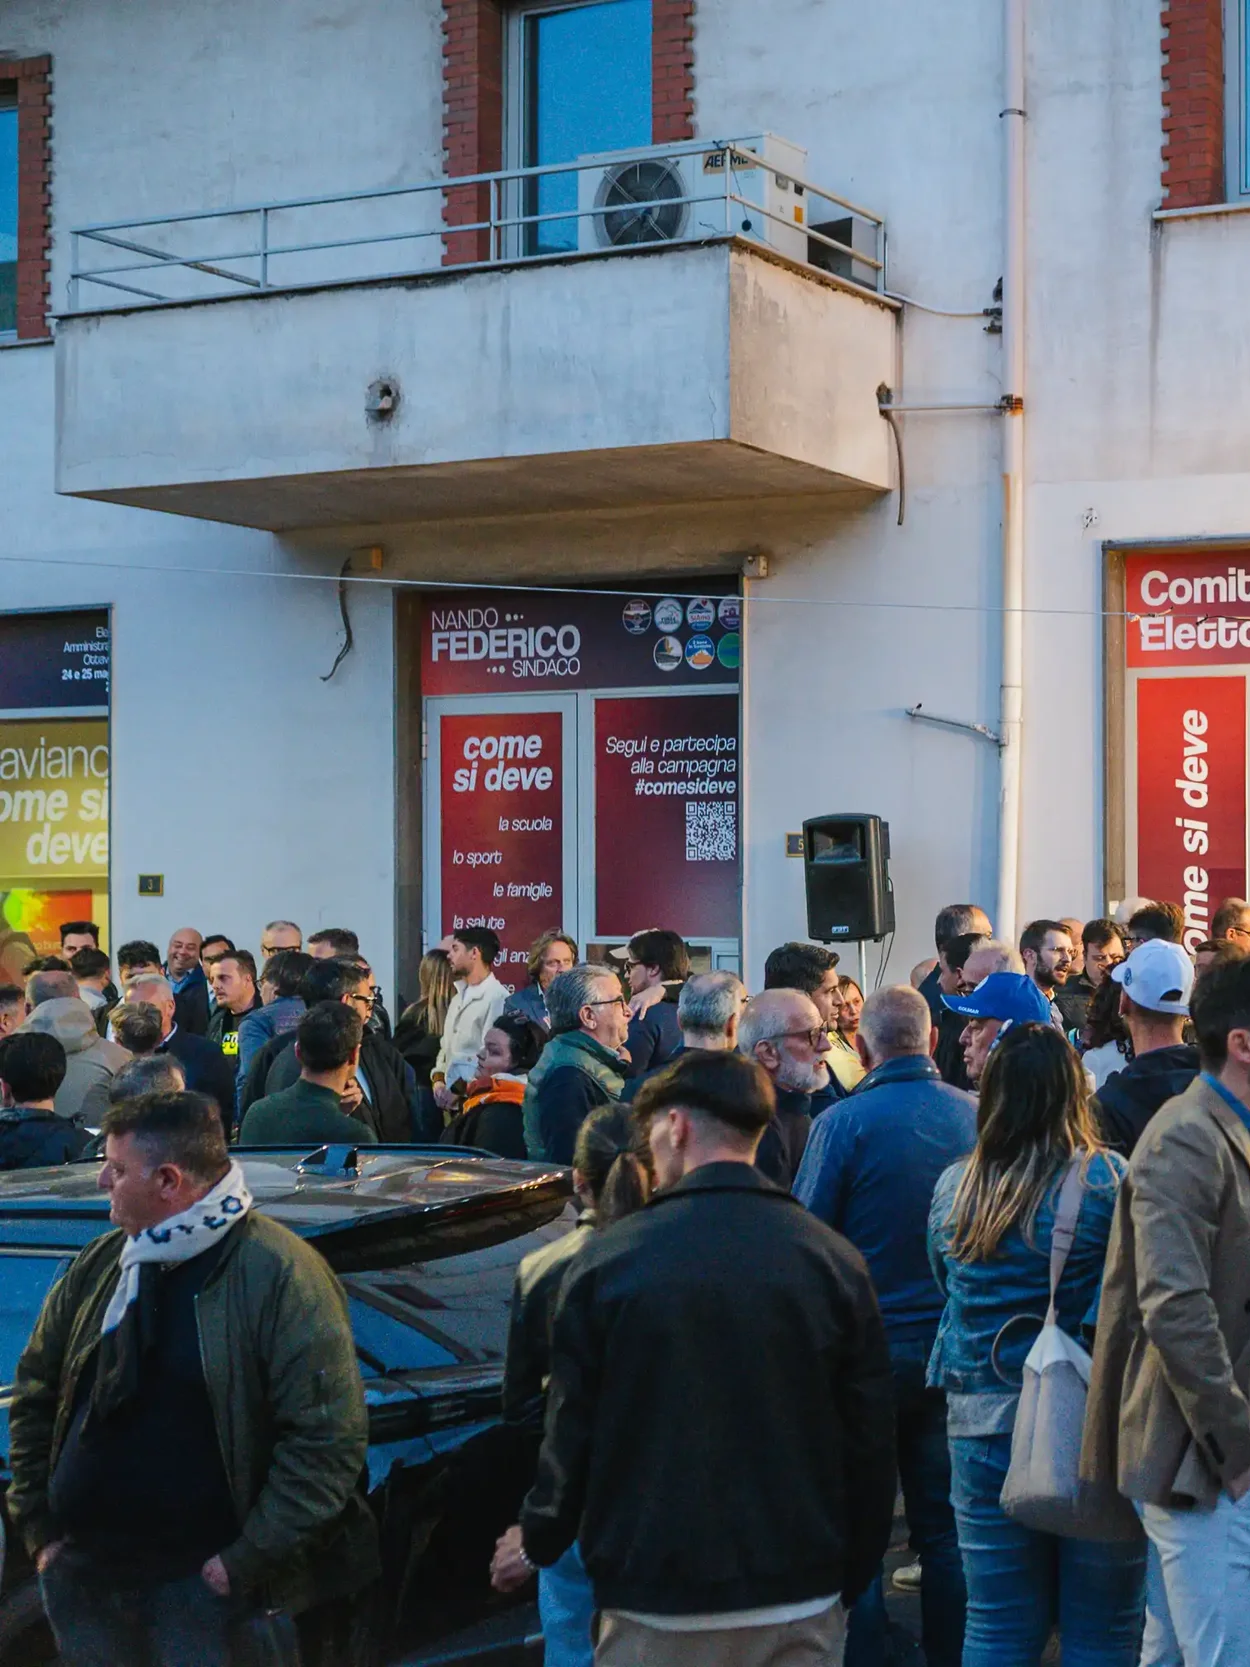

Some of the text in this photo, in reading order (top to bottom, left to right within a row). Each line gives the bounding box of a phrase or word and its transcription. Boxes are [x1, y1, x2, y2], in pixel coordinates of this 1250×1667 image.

[431, 607, 498, 630] NANDO
[431, 625, 581, 662] FEDERICO
[61, 668, 73, 680] 24
[74, 671, 80, 680] e
[81, 667, 93, 680] 25
[512, 657, 580, 677] SINDACO
[463, 734, 542, 760] come
[605, 734, 737, 757] Segui e partecipa
[452, 761, 553, 792] si deve
[630, 758, 736, 778] alla campagna
[634, 777, 736, 795] #comesideve
[79, 779, 109, 822] si
[498, 815, 552, 831] la scuola
[1175, 708, 1209, 958] ome si deve
[26, 822, 109, 865] deve
[452, 849, 502, 868] lo sport
[493, 882, 553, 901] le famiglie
[453, 914, 505, 930] la salute
